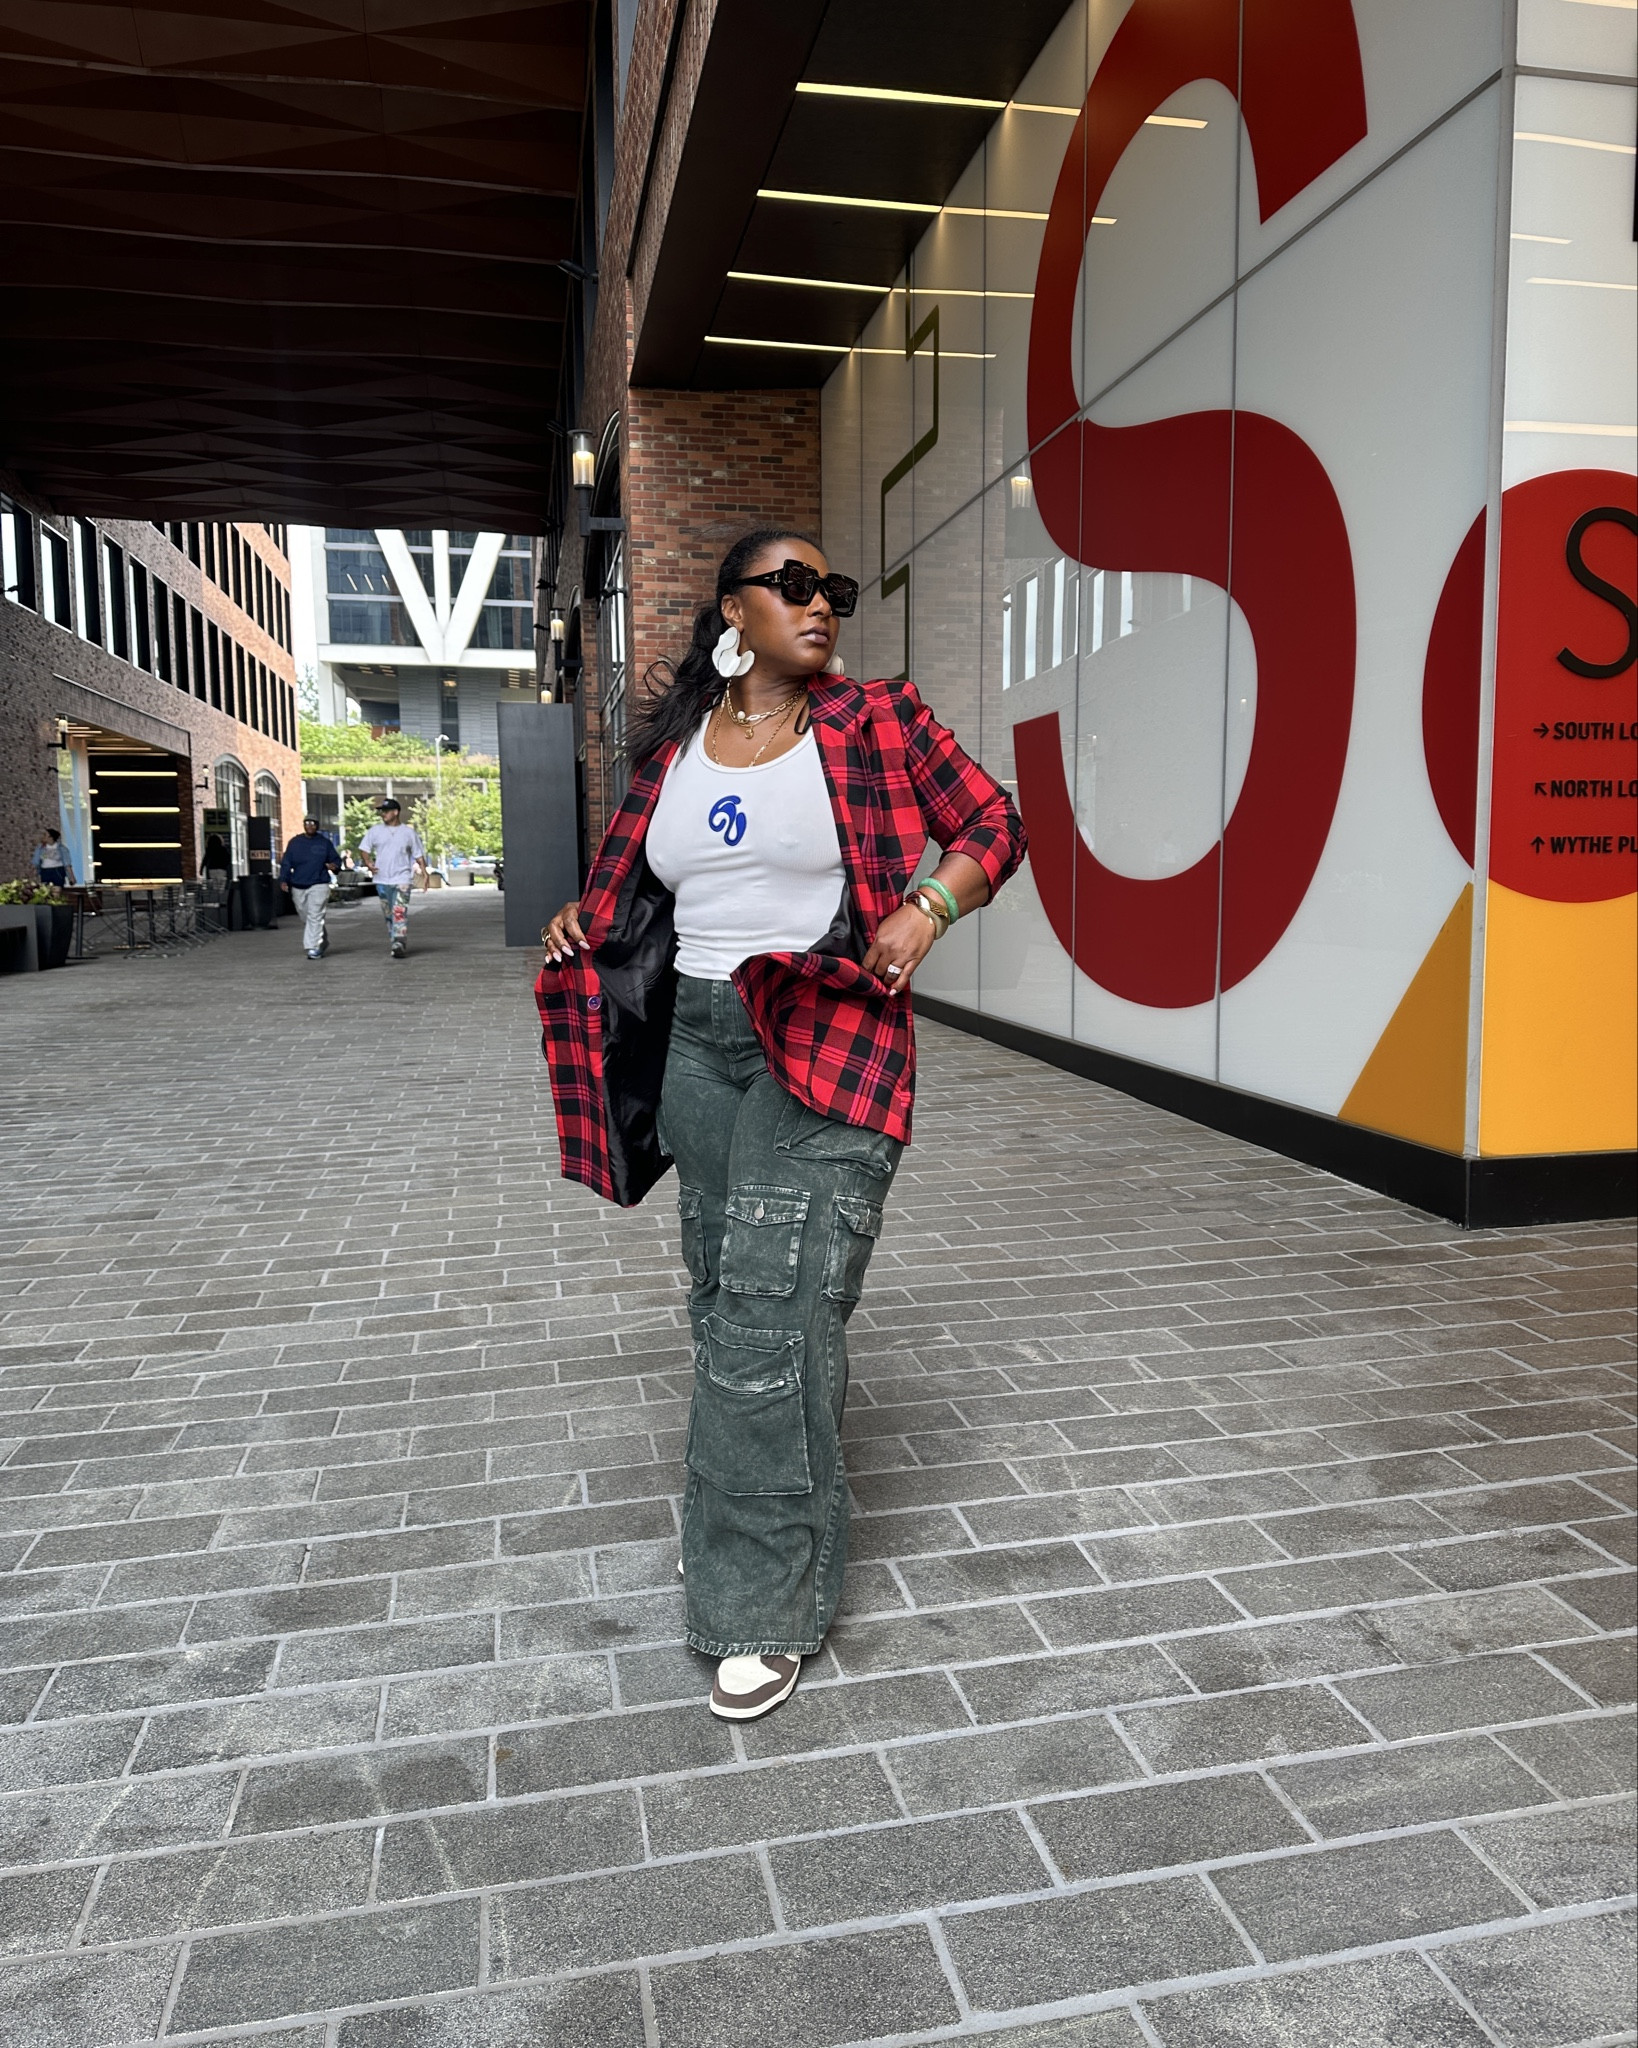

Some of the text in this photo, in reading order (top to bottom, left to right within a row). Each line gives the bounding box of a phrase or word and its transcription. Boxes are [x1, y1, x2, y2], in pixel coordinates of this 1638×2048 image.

[1553, 721, 1614, 740] SOUTH
[1550, 780, 1613, 798] NORTH
[1550, 836, 1613, 854] WYTHE
